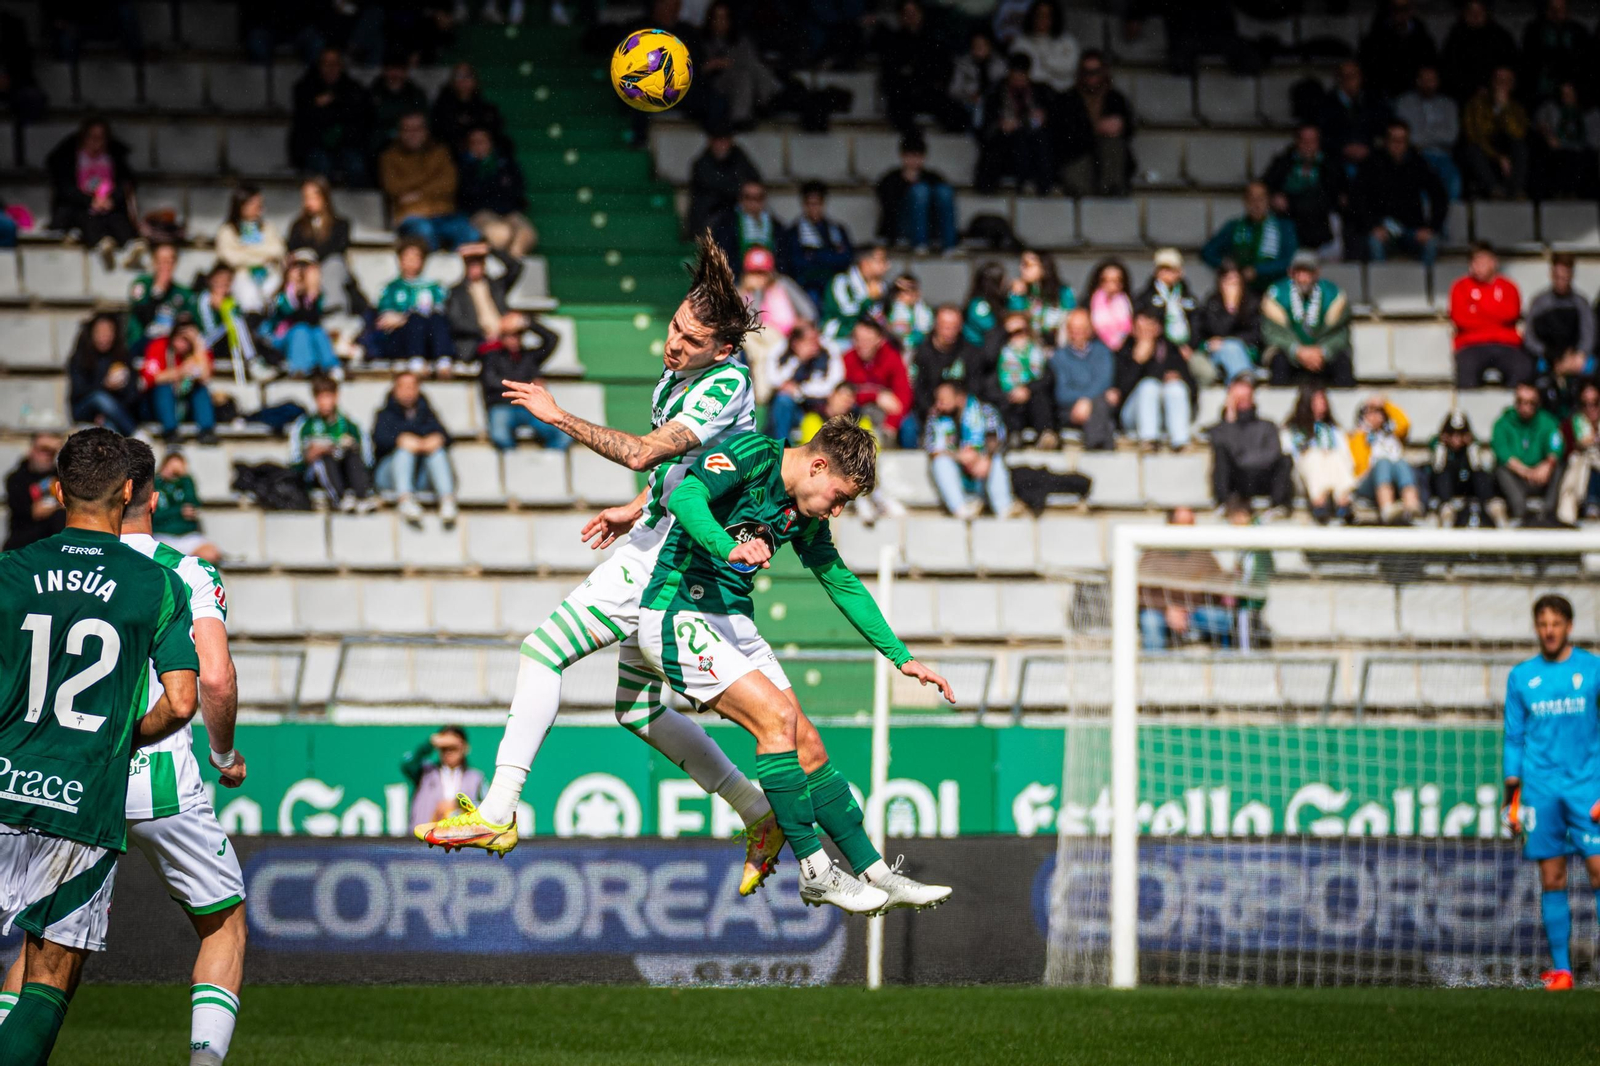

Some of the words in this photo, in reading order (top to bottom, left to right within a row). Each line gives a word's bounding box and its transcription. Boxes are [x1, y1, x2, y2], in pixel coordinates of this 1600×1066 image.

[61, 545, 104, 555] FERROL
[34, 566, 117, 602] INSÚA
[677, 618, 721, 654] 21
[21, 613, 120, 732] 12
[1285, 783, 1512, 837] Galici
[249, 859, 832, 941] CORPOREAS
